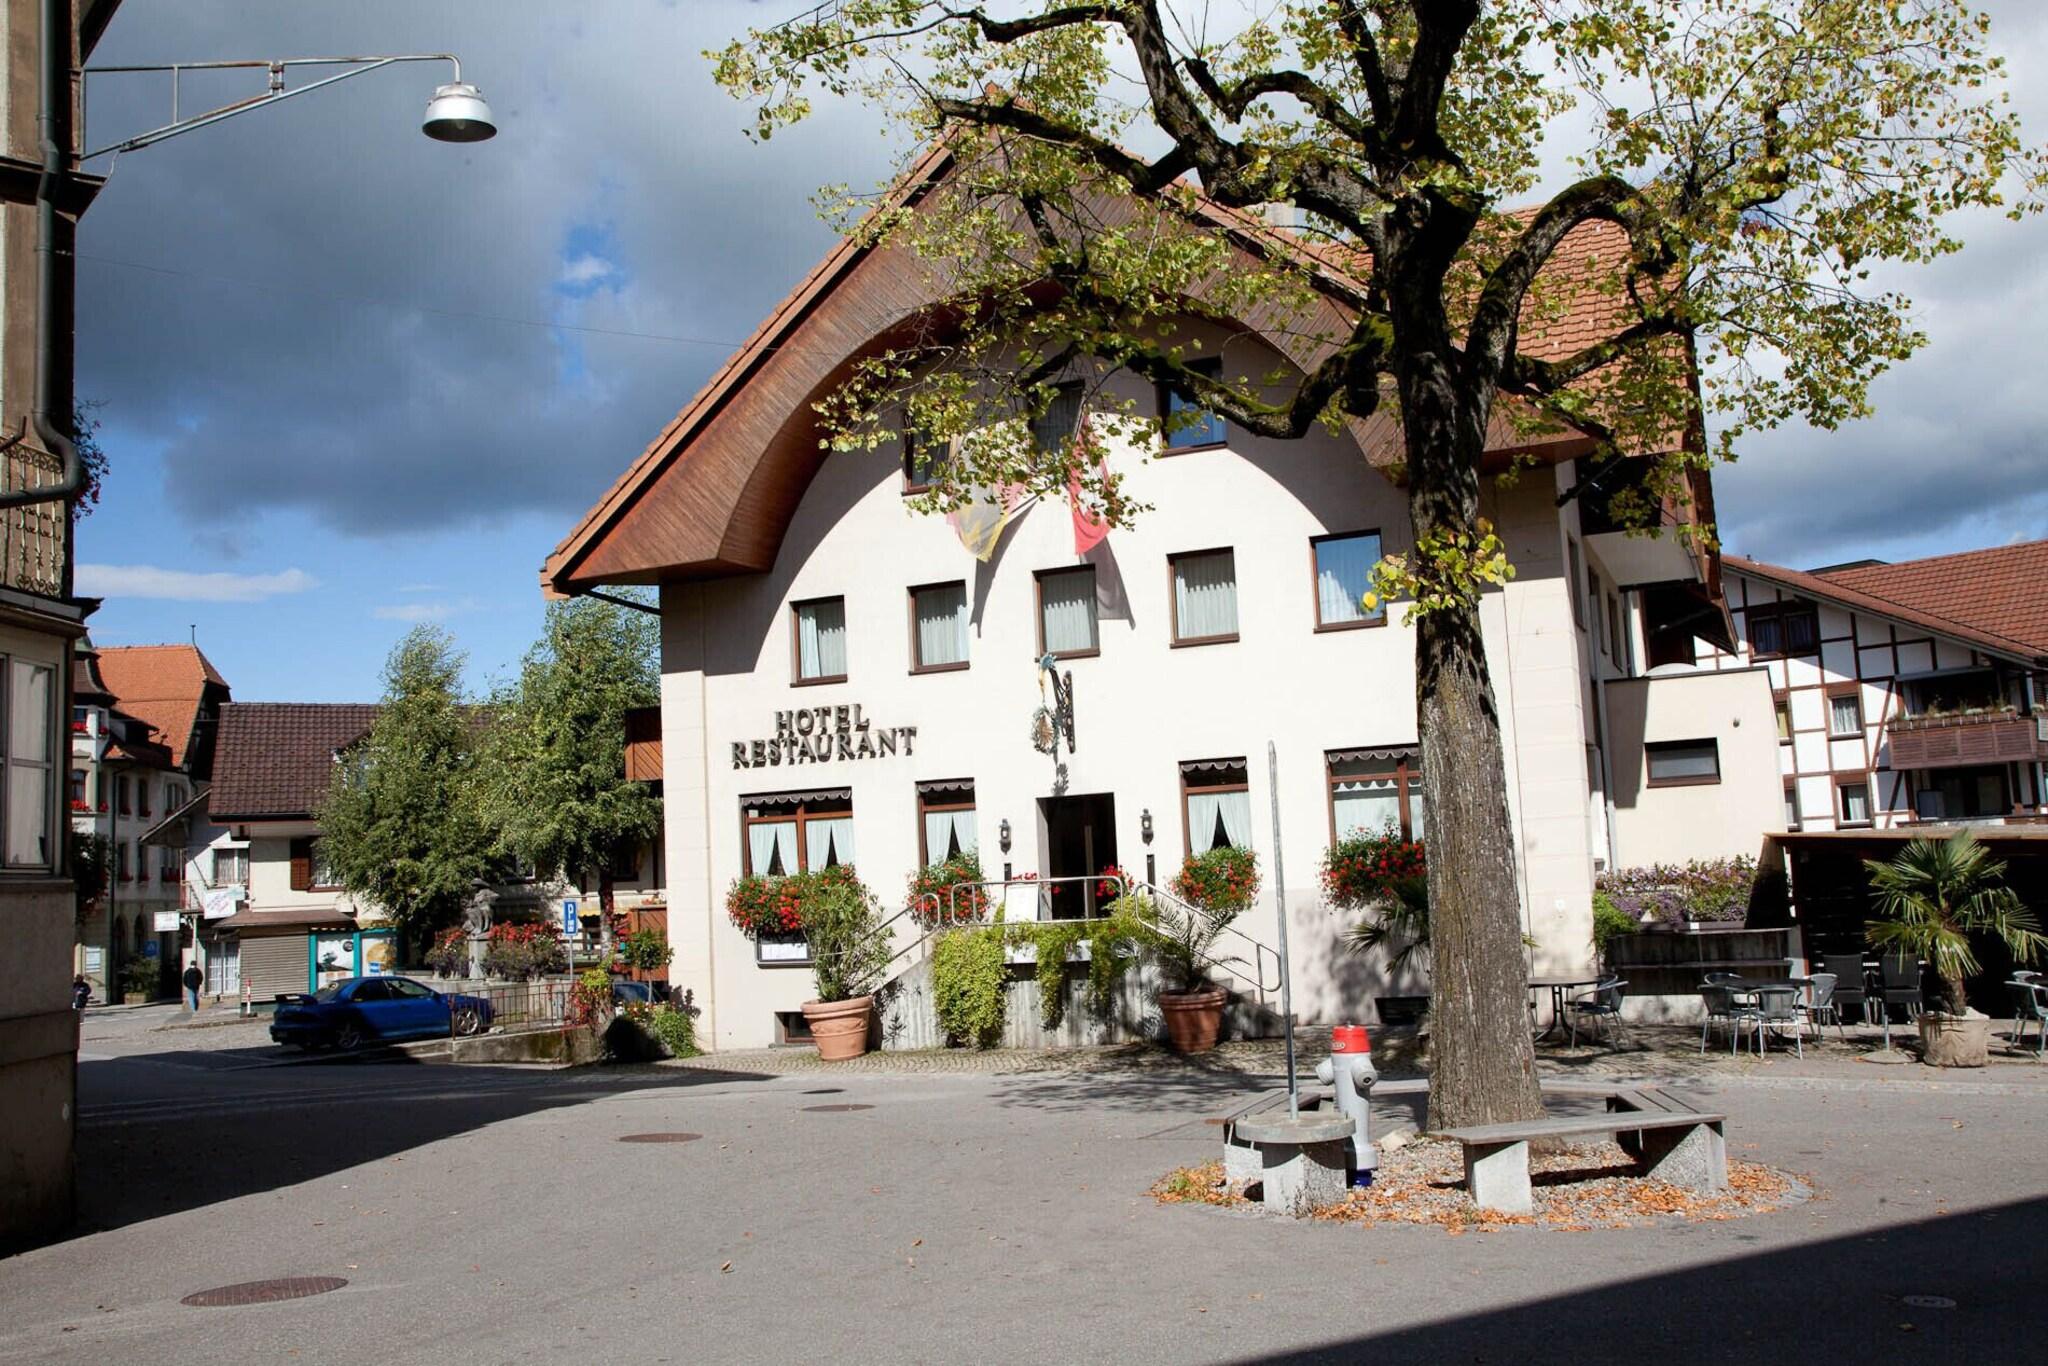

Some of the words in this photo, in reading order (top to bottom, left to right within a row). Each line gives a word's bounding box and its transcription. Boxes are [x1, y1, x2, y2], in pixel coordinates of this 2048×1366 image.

[775, 703, 870, 737] HOTEL
[730, 727, 917, 769] RESTAURANT
[567, 903, 574, 920] P
